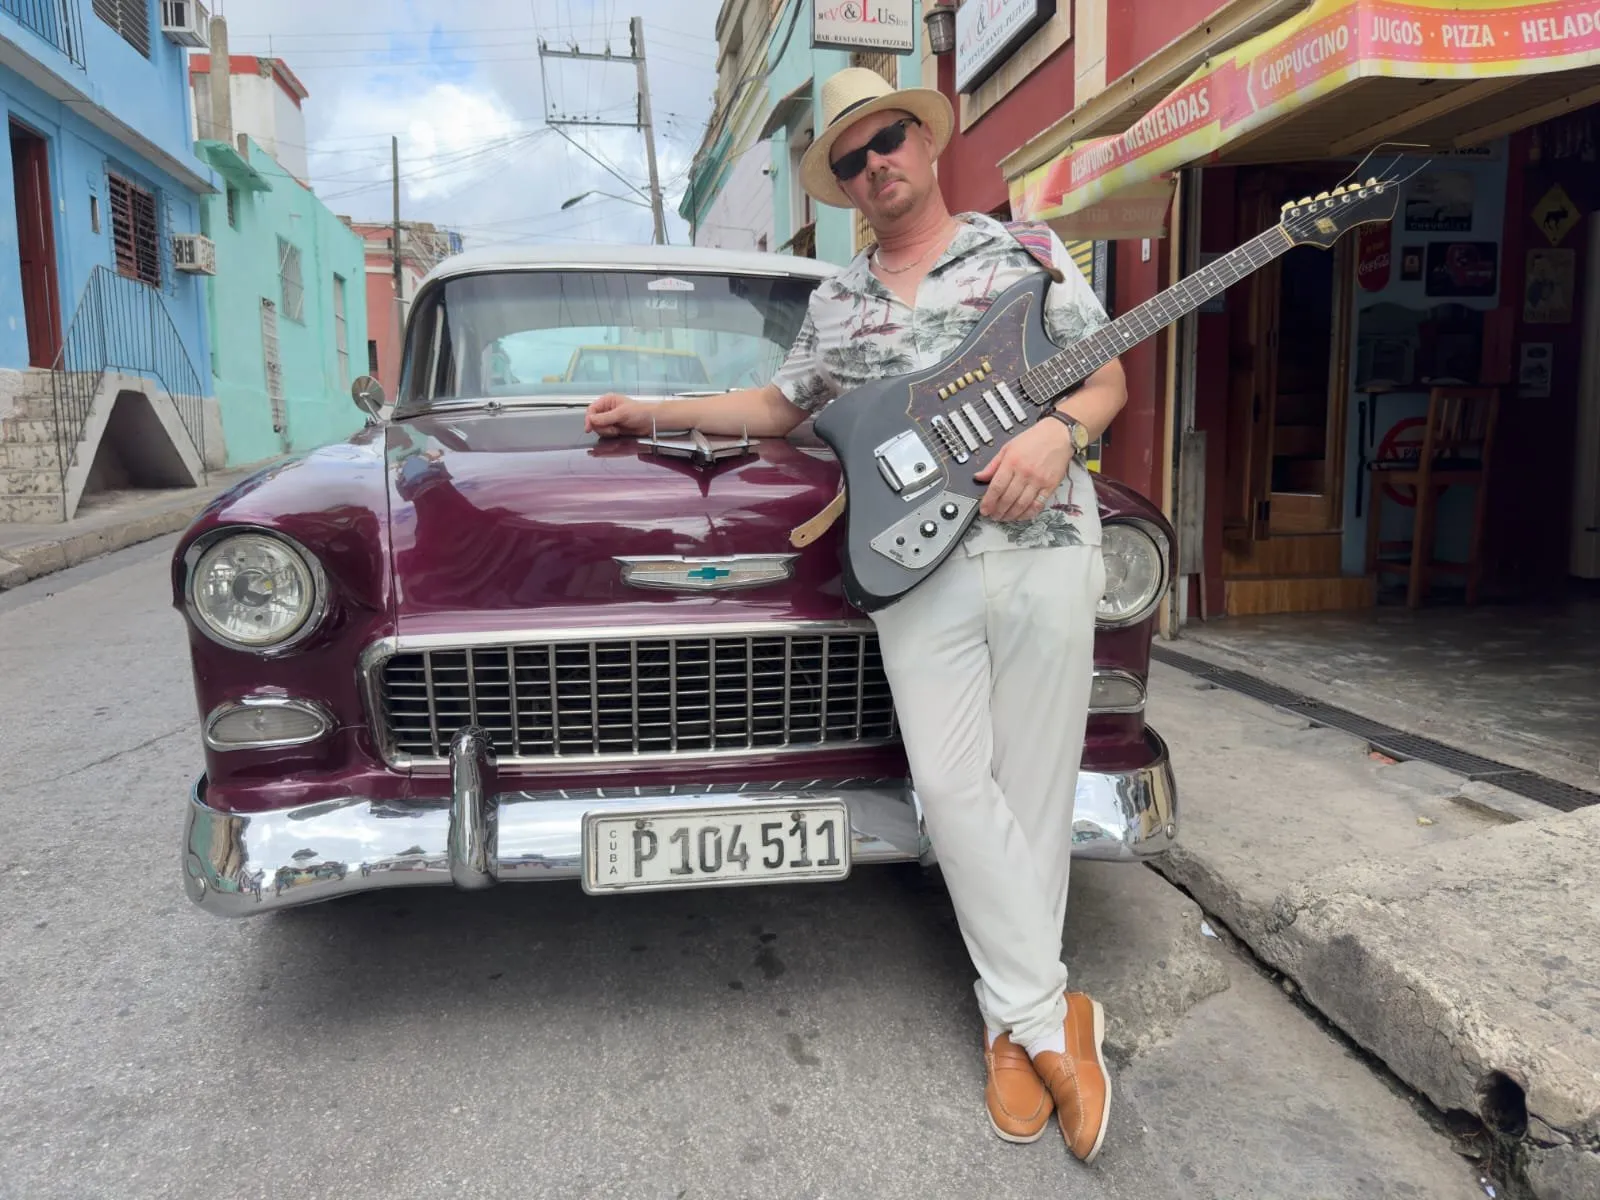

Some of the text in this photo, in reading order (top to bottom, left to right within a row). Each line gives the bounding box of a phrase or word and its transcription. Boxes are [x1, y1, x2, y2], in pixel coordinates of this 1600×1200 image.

[1261, 24, 1349, 90] CAPPUCCINO
[1371, 16, 1423, 46] JUGOS
[1441, 24, 1495, 48] PIZZA
[1123, 87, 1210, 153] MERIENDAS
[609, 830, 618, 875] CUBA
